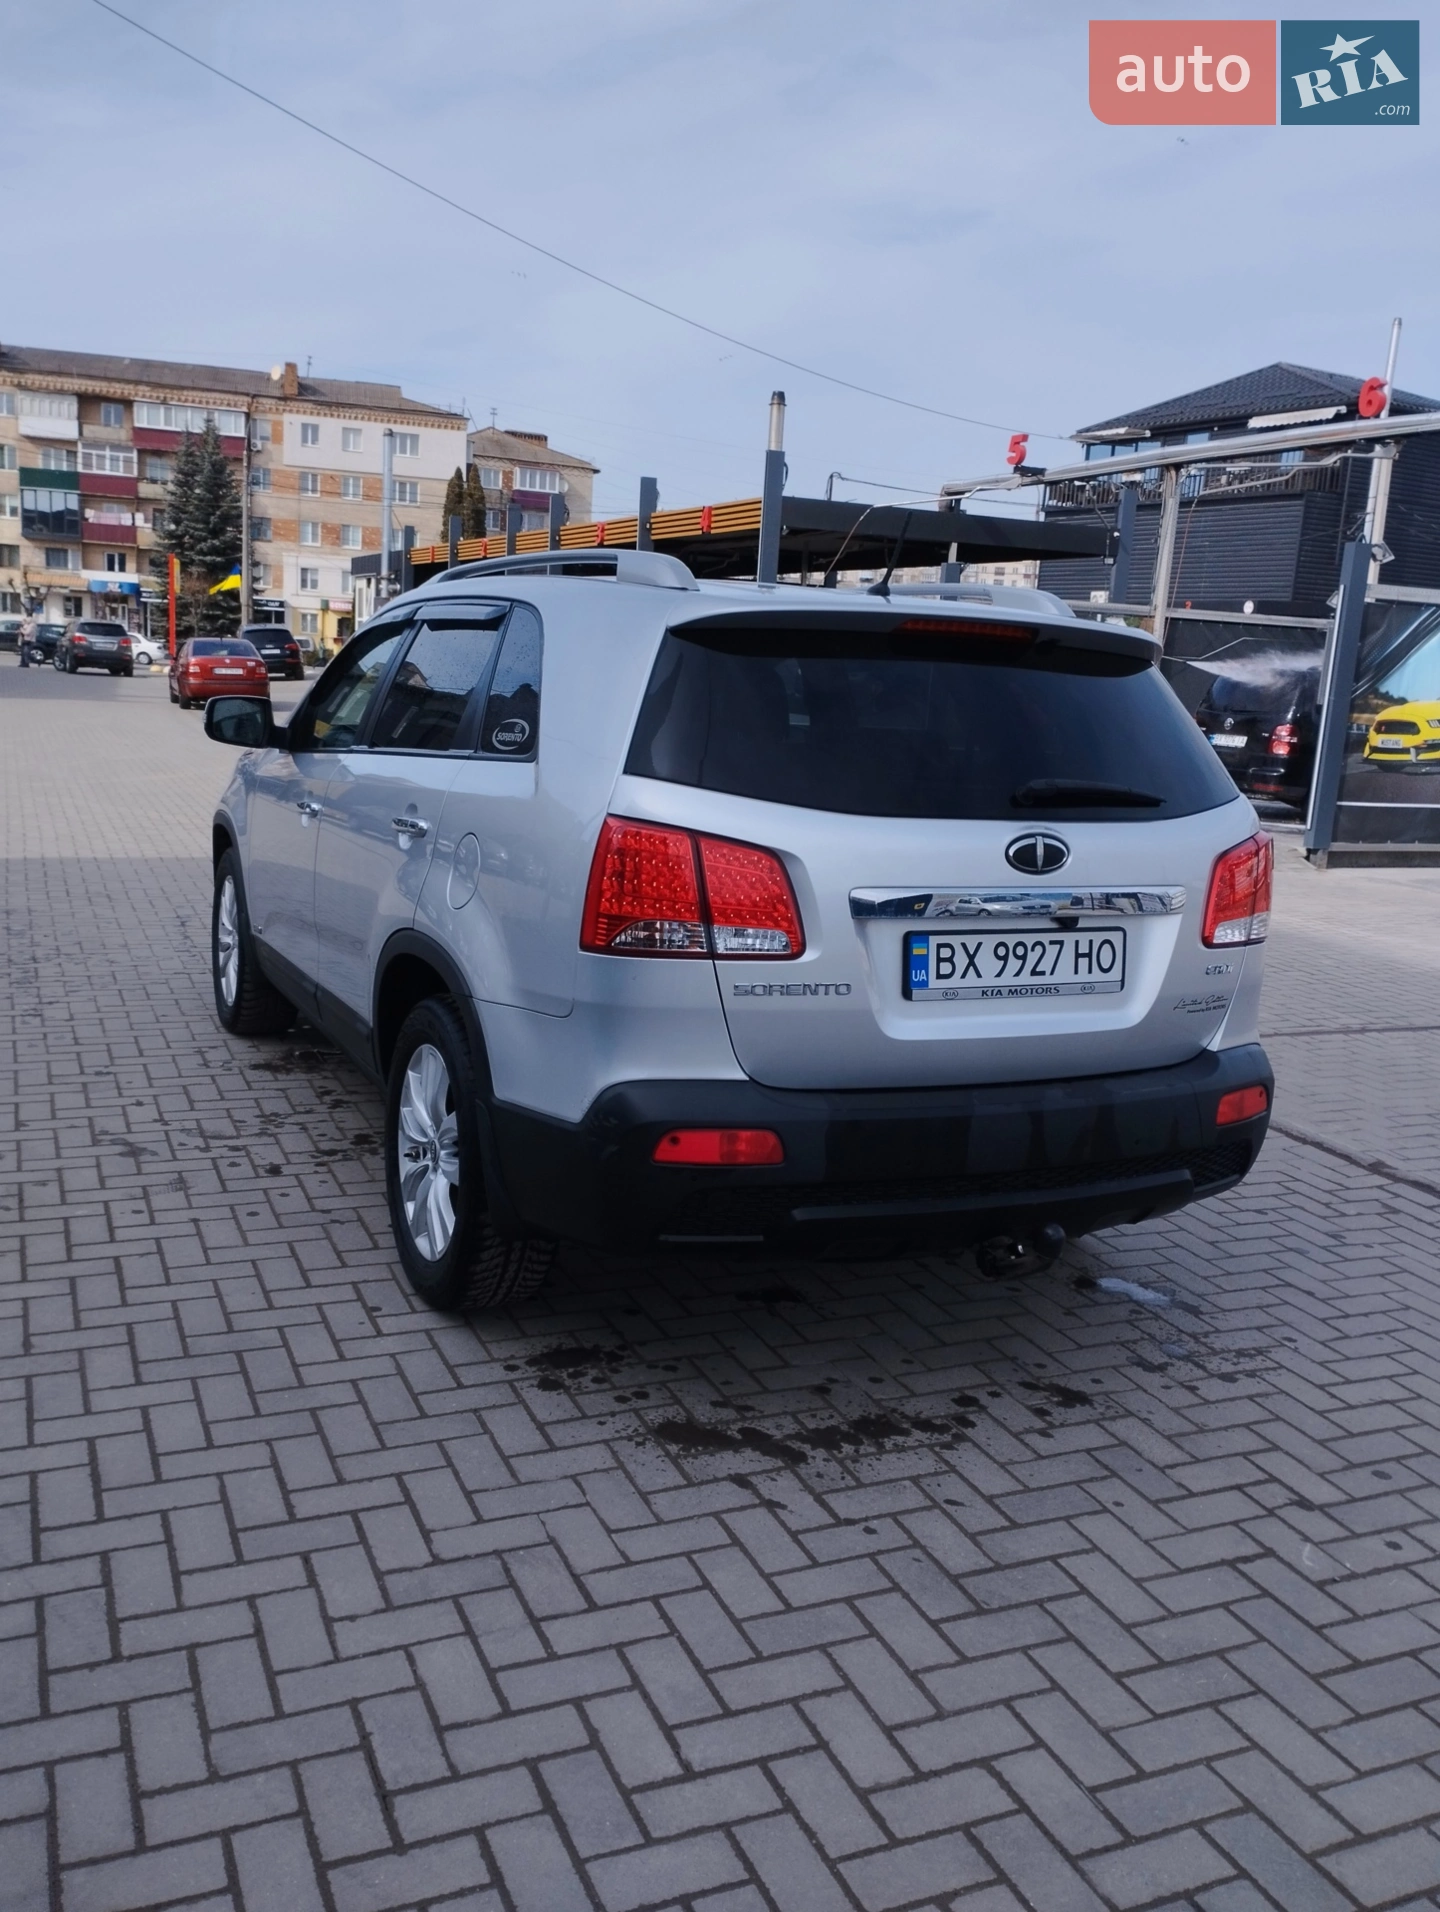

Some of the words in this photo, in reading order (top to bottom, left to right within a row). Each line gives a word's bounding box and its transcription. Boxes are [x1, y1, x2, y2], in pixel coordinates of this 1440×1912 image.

[1358, 376, 1387, 417] 6
[1006, 433, 1029, 465] 5
[700, 506, 712, 533] 4
[596, 521, 607, 546] 3
[496, 731, 523, 742] SORENTO
[935, 941, 983, 980] BX
[993, 939, 1065, 978] 9927
[1073, 938, 1117, 976] HO
[911, 969, 927, 982] UA
[733, 982, 852, 996] SORENTO
[944, 990, 958, 998] KIA
[981, 988, 1003, 997] KIA
[1008, 986, 1060, 996] MOTORS
